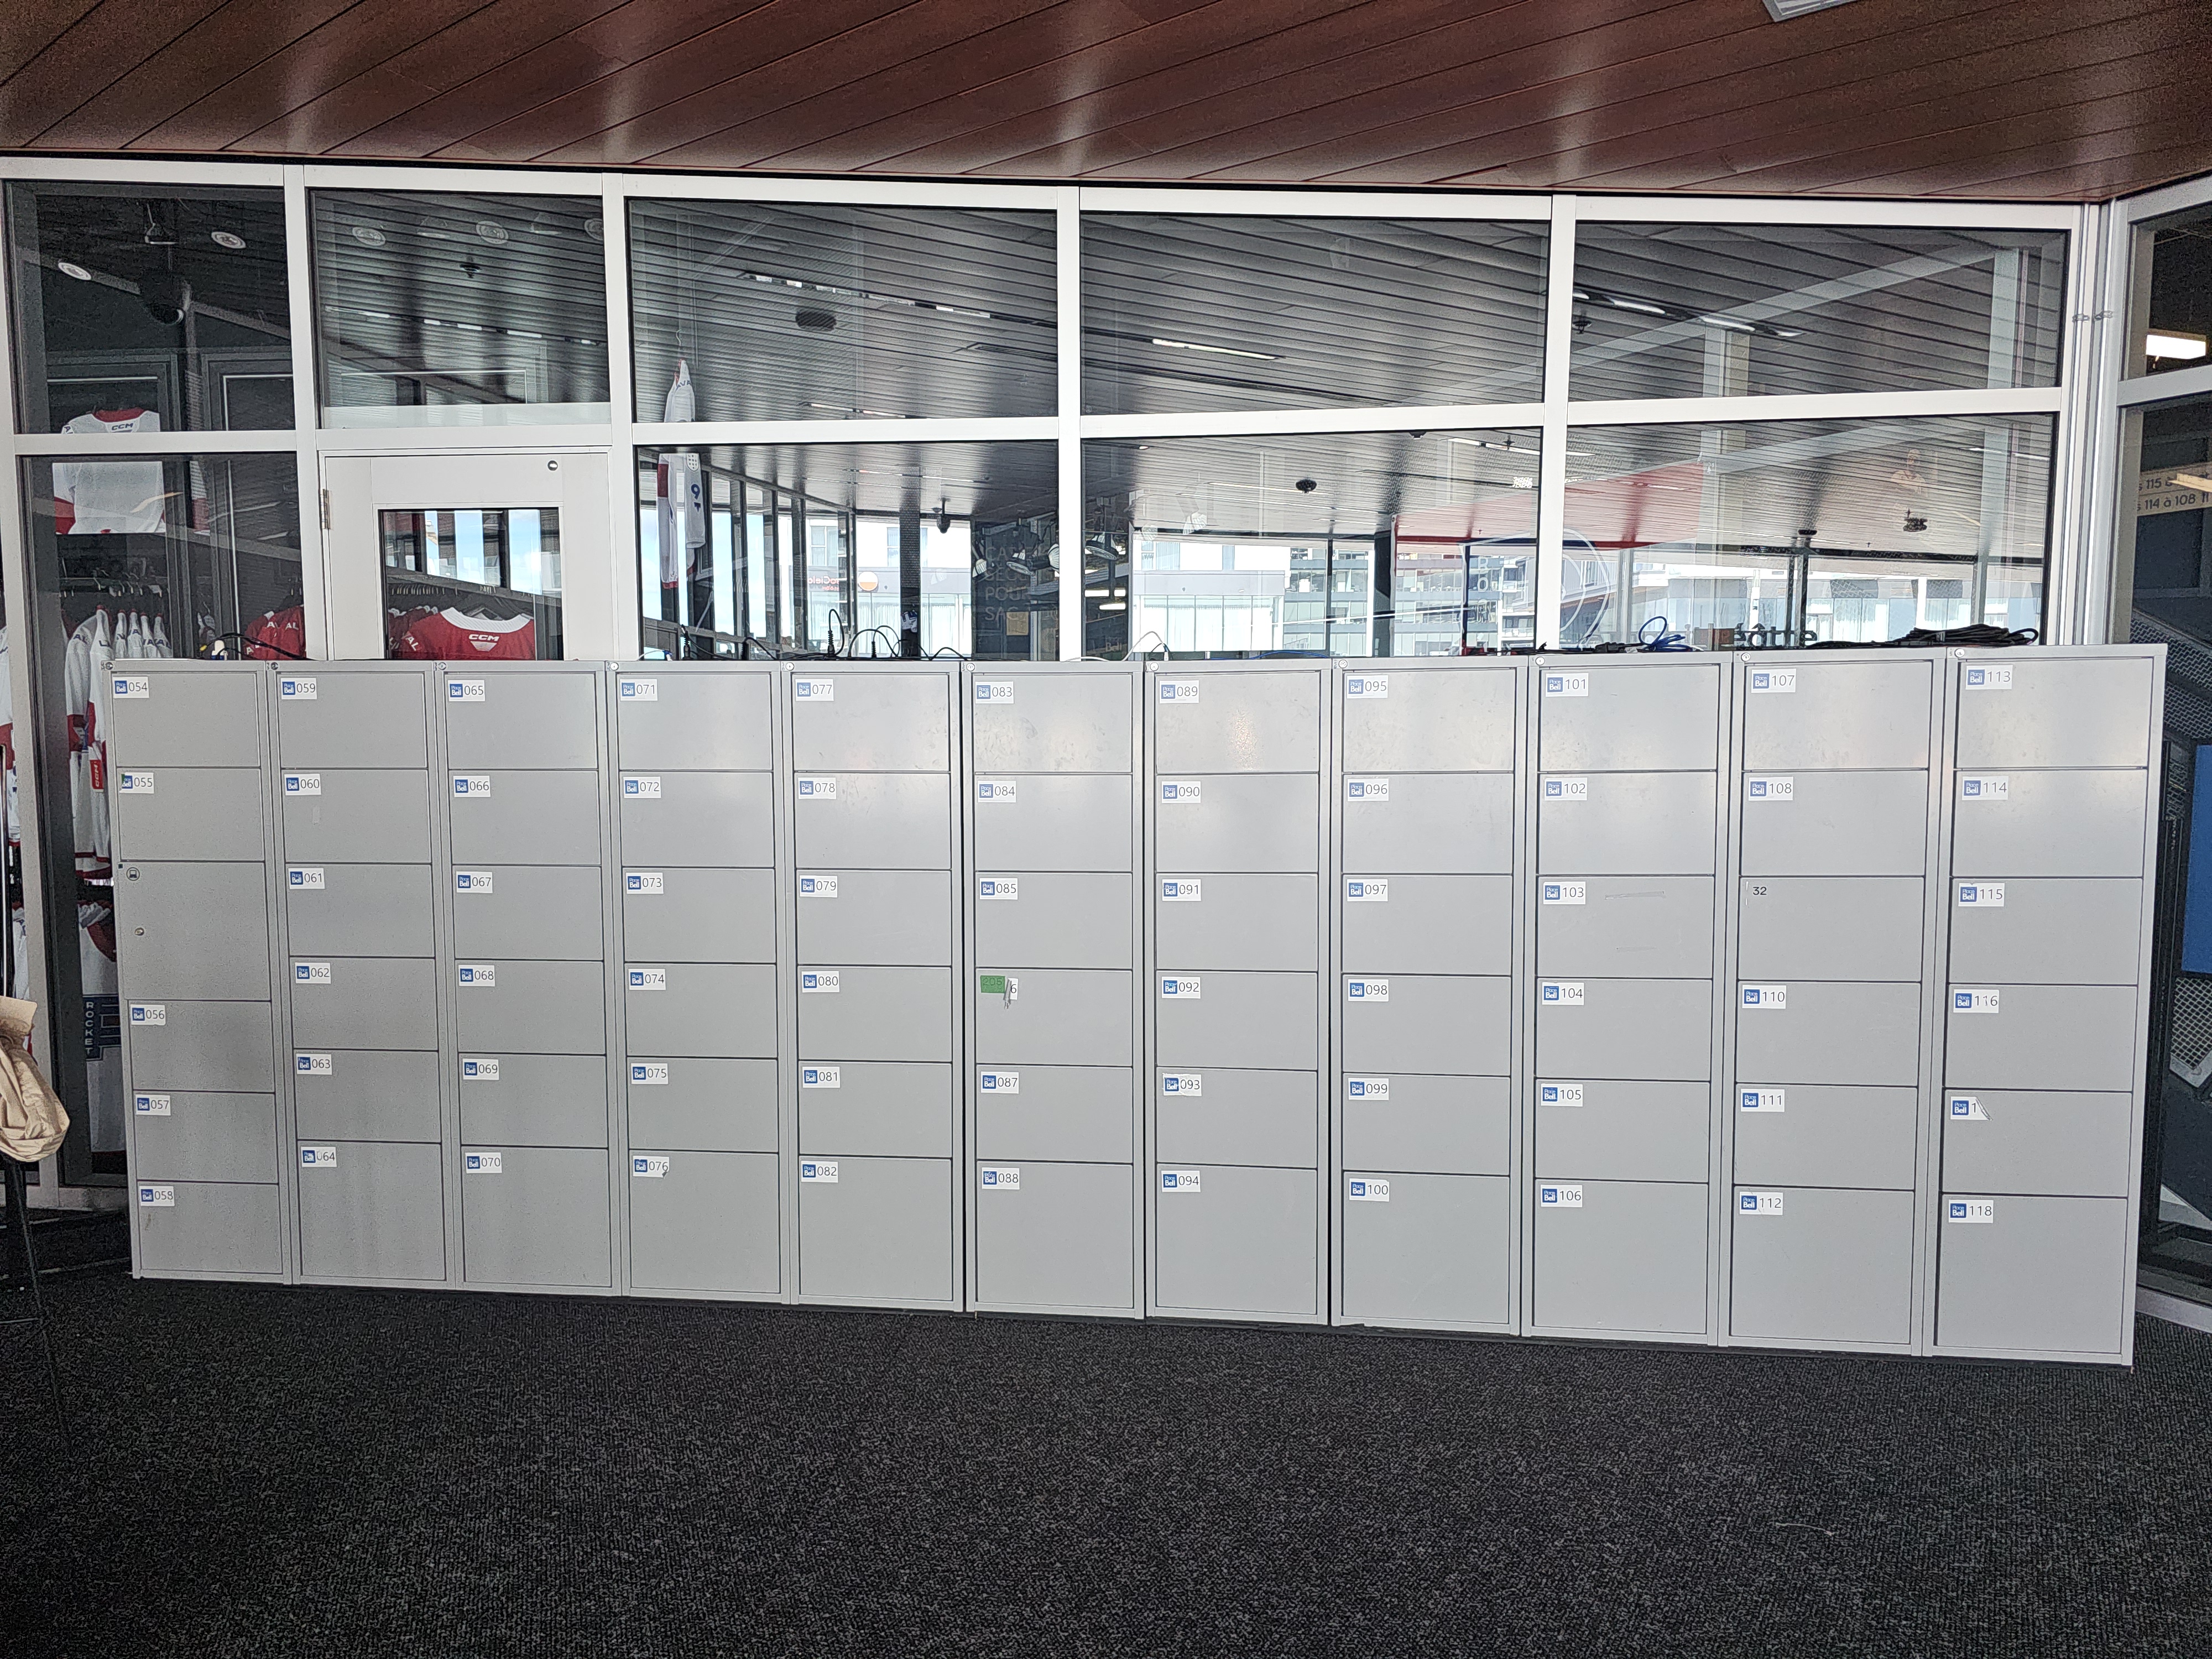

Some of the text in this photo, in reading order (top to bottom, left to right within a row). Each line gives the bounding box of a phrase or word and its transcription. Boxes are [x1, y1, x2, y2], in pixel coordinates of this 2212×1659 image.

[111, 422, 134, 431] CCM
[2146, 477, 2162, 489] 115
[2145, 498, 2160, 510] 114
[2163, 496, 2172, 508] à
[2175, 493, 2197, 506] 108
[468, 634, 499, 642] CCM
[1772, 675, 1795, 686] 107
[1987, 671, 2011, 682] 113
[128, 682, 148, 692] 054
[296, 683, 316, 693] 059
[636, 684, 655, 695] 071
[812, 684, 832, 695] 077
[1365, 681, 1387, 692] 095
[1565, 679, 1585, 690] 101
[464, 685, 484, 696] 065
[992, 686, 1013, 697] 083
[1177, 686, 1198, 697] 089
[134, 777, 153, 787] 055
[300, 779, 320, 789] 060
[469, 781, 489, 791] 066
[640, 781, 660, 792] 072
[815, 782, 836, 793] 078
[1984, 782, 2007, 793] 114
[994, 786, 1015, 796] 084
[1178, 786, 1200, 797] 090
[1365, 784, 1387, 795] 096
[1564, 783, 1586, 794] 102
[1769, 782, 1792, 794] 108
[304, 873, 322, 883] 061
[472, 877, 492, 887] 067
[642, 877, 662, 888] 073
[816, 880, 836, 891] 079
[996, 883, 1016, 894] 085
[1179, 884, 1198, 895] 091
[1365, 884, 1387, 895] 097
[1752, 886, 1767, 895] 32
[1562, 887, 1584, 898] 103
[1980, 889, 2003, 900] 115
[311, 967, 330, 978] 062
[474, 970, 494, 980] 068
[645, 974, 665, 984] 074
[818, 976, 838, 986] 080
[1178, 982, 1199, 992] 092
[1365, 984, 1387, 995] 098
[1561, 988, 1583, 998] 104
[1762, 992, 1785, 1002] 110
[1974, 995, 1998, 1006] 116
[145, 1009, 165, 1020] 056
[85, 1001, 95, 1055] ROCKET
[311, 1058, 331, 1069] 063
[478, 1064, 498, 1074] 069
[647, 1068, 667, 1078] 075
[818, 1071, 837, 1082] 081
[997, 1077, 1018, 1087] 087
[1180, 1079, 1200, 1090] 093
[1366, 1083, 1387, 1094] 099
[1560, 1089, 1582, 1100] 105
[1761, 1095, 1781, 1105] 111
[150, 1099, 169, 1109] 057
[481, 1157, 500, 1167] 070
[649, 1161, 669, 1171] 076
[817, 1166, 837, 1176] 082
[998, 1173, 1019, 1183] 088
[1178, 1176, 1199, 1186] 094
[1368, 1185, 1389, 1195] 100
[1559, 1190, 1582, 1201] 106
[154, 1191, 174, 1201] 058
[1760, 1198, 1781, 1208] 112
[1969, 1206, 1992, 1216] 118
